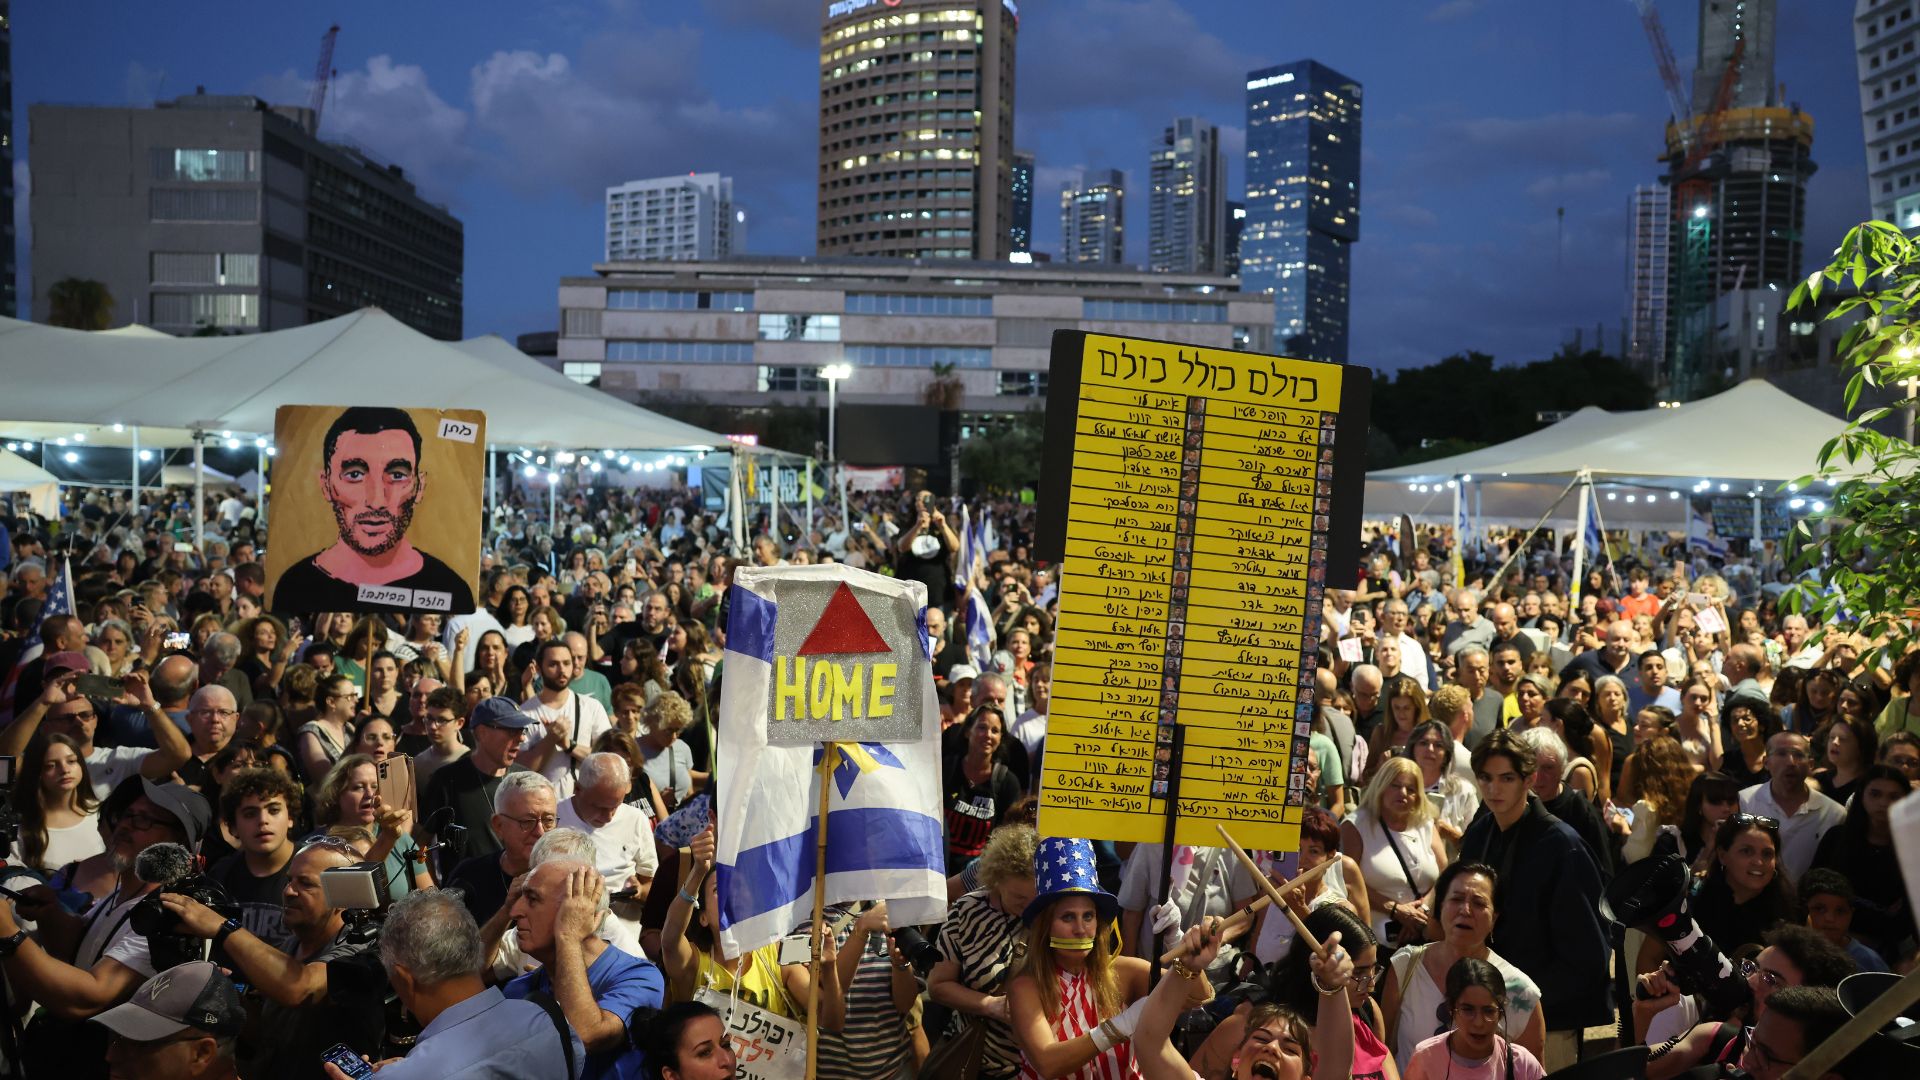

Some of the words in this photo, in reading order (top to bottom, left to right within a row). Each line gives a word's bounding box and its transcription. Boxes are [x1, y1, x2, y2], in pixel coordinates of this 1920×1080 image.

[1097, 341, 1167, 383] כולם
[1179, 349, 1236, 391] כולל
[1248, 361, 1318, 402] כולם
[1134, 393, 1148, 407] לוי
[1155, 397, 1179, 409] איתן
[1129, 412, 1151, 425] קוניו
[1162, 415, 1180, 426] דוד
[1300, 415, 1314, 425] בר
[442, 422, 472, 437] מתן
[1257, 429, 1287, 441] ברמן
[1297, 429, 1312, 444] גלי
[1122, 445, 1151, 462] כלפון
[1155, 451, 1176, 461] שגב
[1253, 444, 1285, 457] שרעבי
[1293, 448, 1312, 460] יוסי
[1123, 462, 1151, 478] גולדין
[1238, 459, 1266, 473] קופר
[1273, 466, 1311, 477] עמירם
[1115, 480, 1132, 489] אור
[1139, 483, 1174, 495] אבינתן
[1282, 479, 1311, 493] דניאל
[1103, 496, 1149, 510] ברסלבסקי
[1156, 503, 1174, 512] רום
[1290, 498, 1309, 513] גיא
[1114, 517, 1138, 529] הימן
[1150, 521, 1172, 532] ענבר
[1258, 515, 1272, 526] חן
[1280, 517, 1304, 529] איתי
[1156, 537, 1168, 550] רן
[1280, 535, 1302, 548] מתן
[1144, 554, 1166, 567] מתן
[1285, 553, 1303, 565] מני
[1231, 560, 1266, 576] נאוטרה
[1277, 569, 1301, 579] עומר
[1140, 571, 1166, 583] ליאור
[1106, 585, 1130, 599] הורן
[1237, 582, 1256, 593] דוד
[1265, 585, 1299, 596] אביתר
[361, 589, 406, 602] הביתה!
[418, 594, 445, 608] חוזר
[1139, 589, 1163, 603] איתן
[1241, 600, 1264, 611] אדר
[1274, 603, 1298, 615] תמיר
[1136, 605, 1163, 621] ביפין
[1112, 621, 1133, 633] אהל
[1139, 623, 1162, 638] אלון
[1230, 617, 1263, 631] נמרודי
[1273, 621, 1297, 632] תמיר
[1085, 639, 1113, 650] אוחנה
[1138, 639, 1160, 651] יוסף
[1268, 639, 1294, 649] אריה
[1237, 649, 1268, 665] דניאל
[1109, 658, 1131, 674] ברוך
[1137, 661, 1159, 671] סהר
[1279, 659, 1294, 671] עוז
[1212, 668, 1253, 681] מרגלית
[775, 655, 897, 721] HOME
[1136, 677, 1158, 690] רונן
[1100, 691, 1121, 704] כהן
[1127, 694, 1153, 706] נמרוד
[1258, 689, 1290, 704] אלקנה
[1139, 711, 1155, 722] טל
[1239, 706, 1268, 718] ברמן
[1276, 708, 1289, 719] זיו
[1090, 723, 1123, 737] אילוז
[1236, 720, 1254, 729] מור
[1263, 722, 1288, 735] איתן
[1130, 725, 1151, 741] גיא
[1073, 742, 1101, 755] ברוך
[1237, 737, 1259, 747] אור
[1263, 739, 1286, 749] דרור
[1111, 742, 1149, 757] אוריאל
[1084, 761, 1108, 773] קוניו
[1115, 762, 1147, 775] אריאל
[1211, 754, 1243, 770] הרקין
[1248, 758, 1283, 774] מקסים
[1058, 774, 1104, 790] אלאטרש
[1222, 773, 1244, 786] מירן
[1252, 776, 1279, 787] עמרי
[1110, 782, 1144, 793] מוחמד
[1255, 788, 1280, 802] אסף
